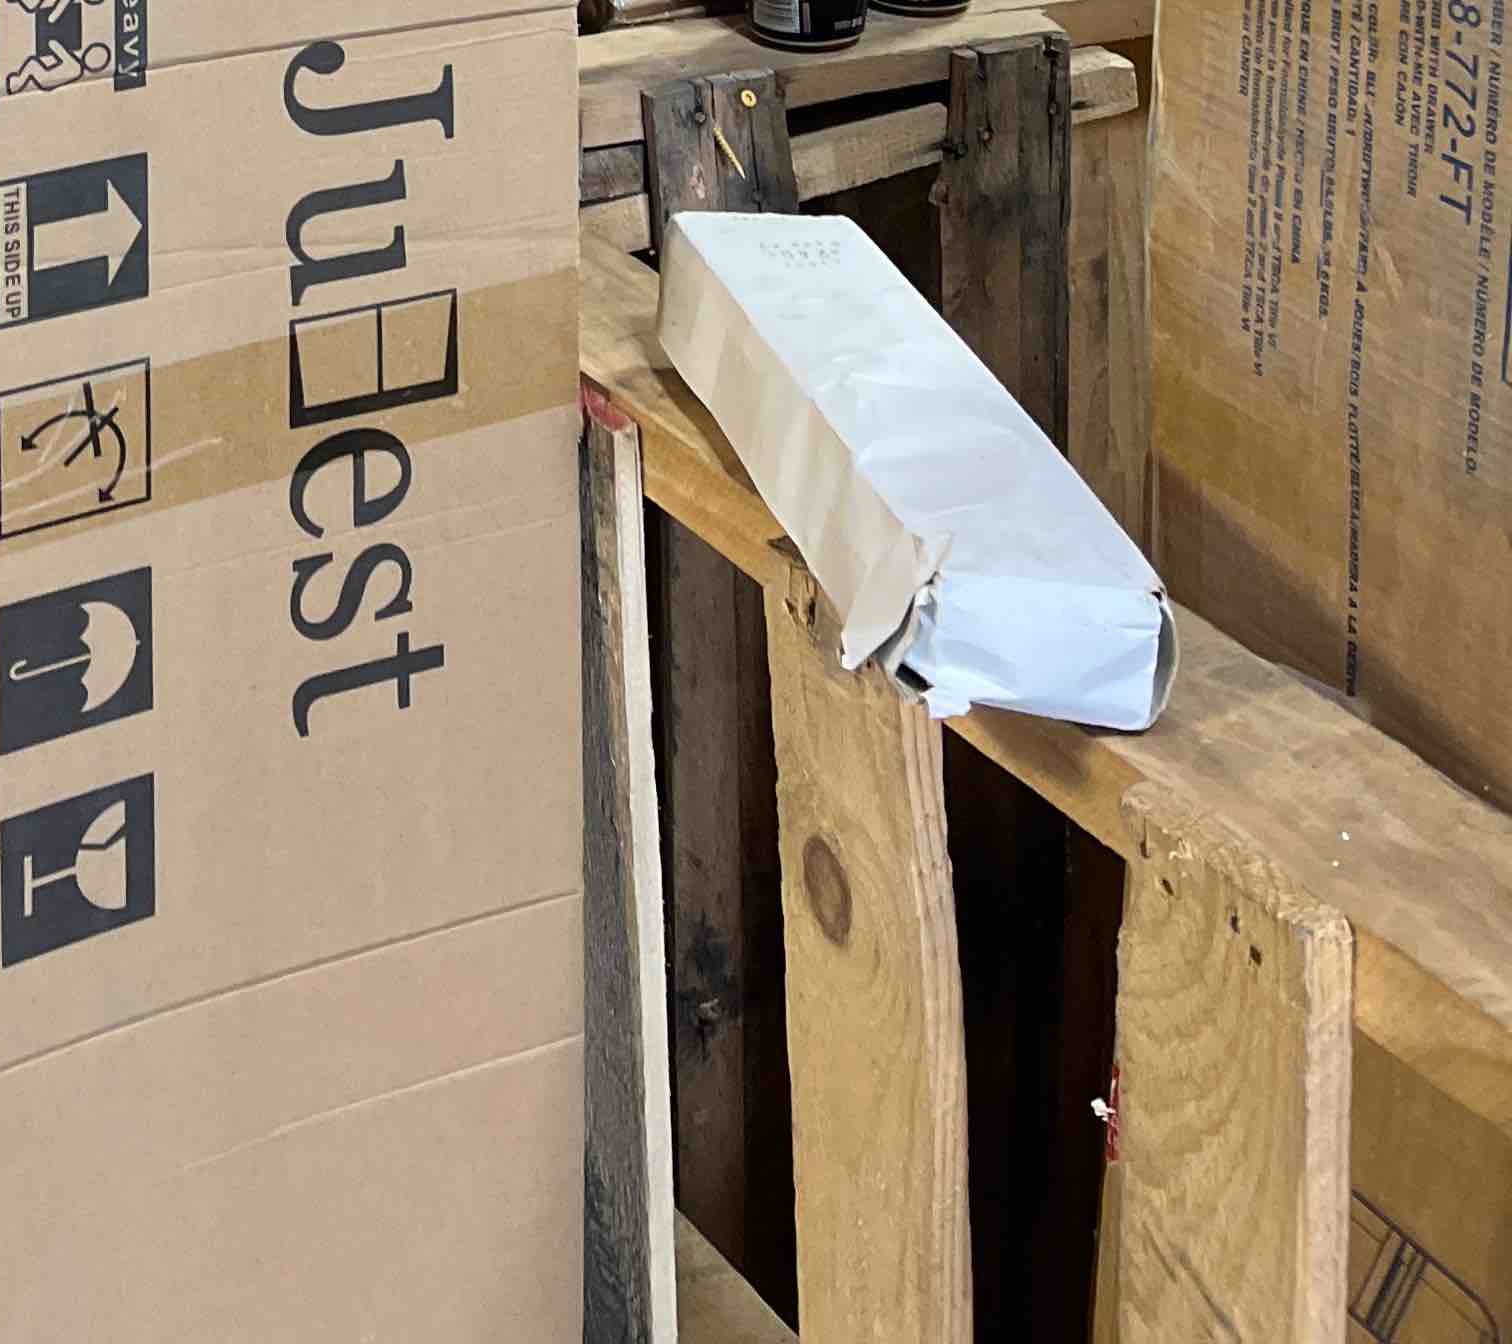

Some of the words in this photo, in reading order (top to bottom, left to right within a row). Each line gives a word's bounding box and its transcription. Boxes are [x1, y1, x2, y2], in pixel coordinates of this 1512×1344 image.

[1330, 8, 1342, 52] BRUT
[1428, 35, 1441, 78] WITH
[1328, 65, 1340, 110] PESO
[1409, 91, 1422, 135] AVEC
[1424, 83, 1438, 154] DRAWER
[1484, 150, 1497, 176] DE
[2, 186, 21, 237] THIS
[3, 243, 22, 290] SIDE
[4, 293, 22, 320] UP
[1470, 360, 1484, 386] DE
